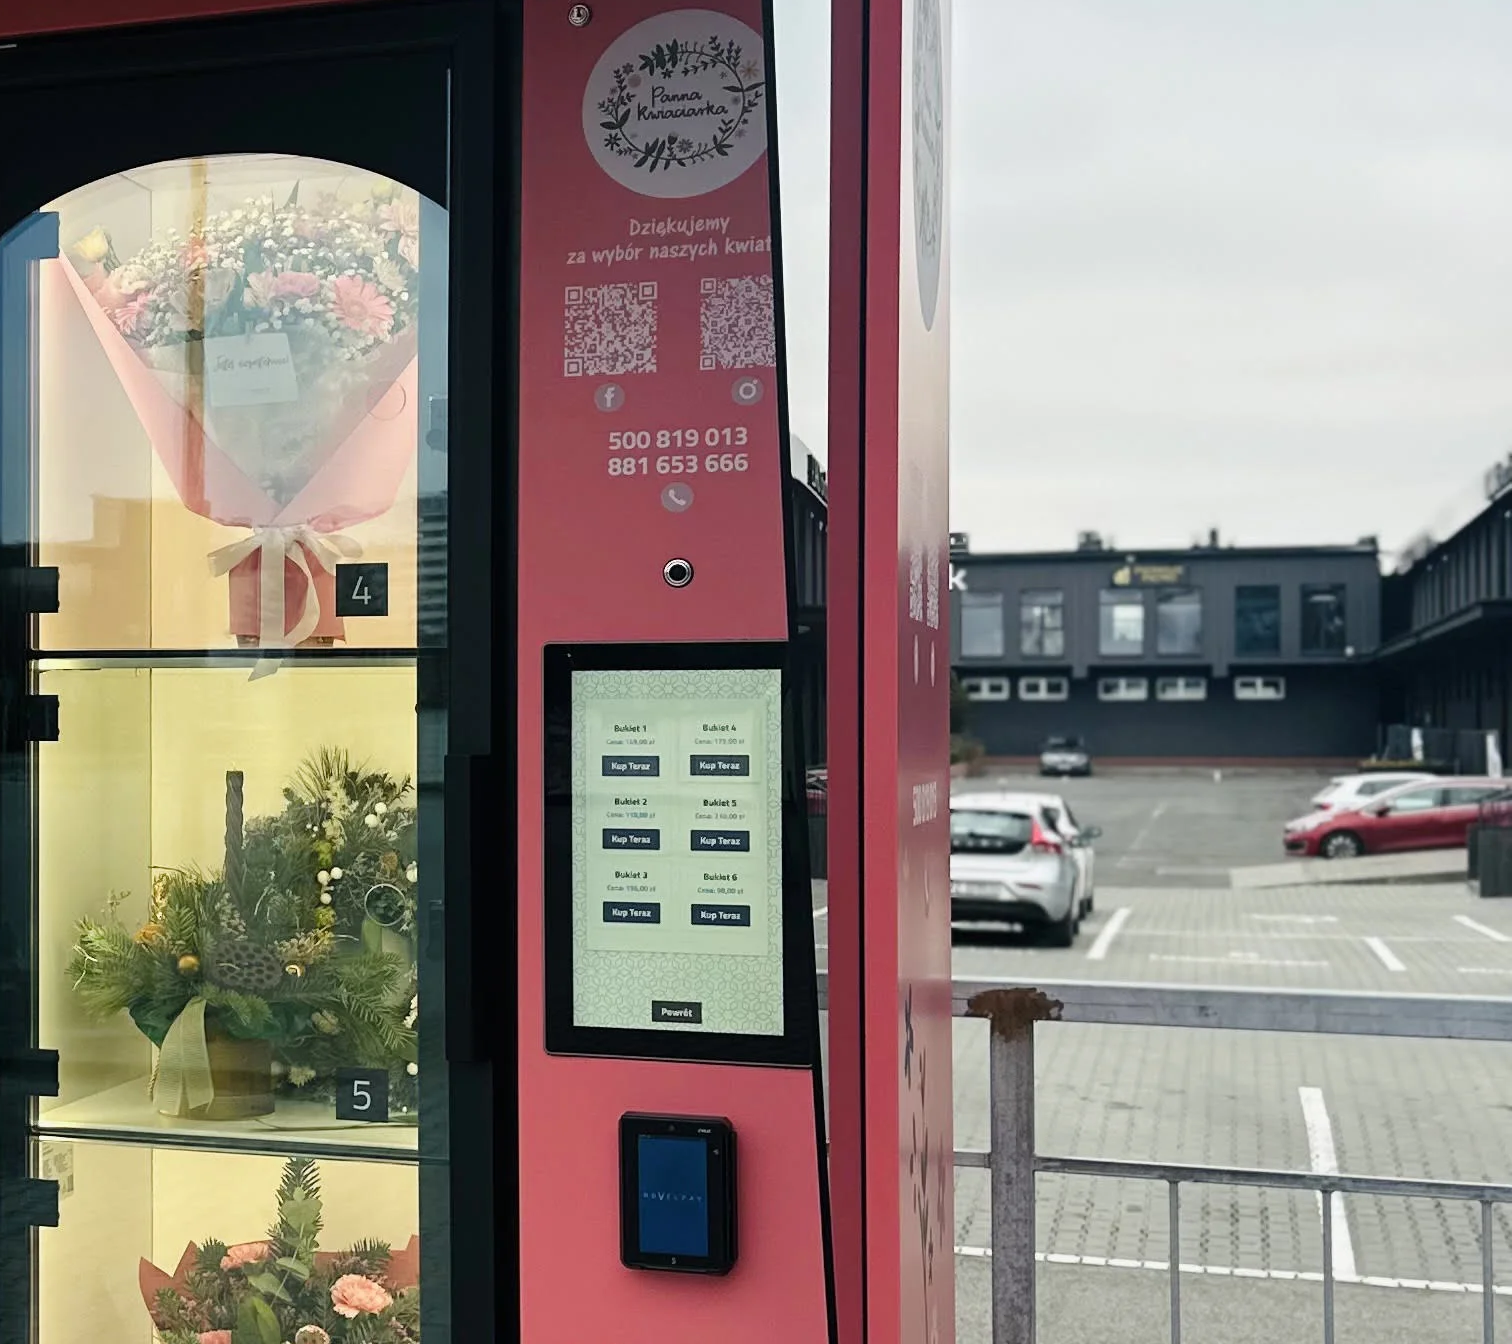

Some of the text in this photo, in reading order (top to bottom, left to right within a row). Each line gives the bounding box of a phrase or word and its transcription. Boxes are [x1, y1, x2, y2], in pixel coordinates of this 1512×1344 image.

[651, 85, 703, 108] Panna
[629, 216, 731, 237] Dziękujemy
[566, 249, 586, 265] za
[592, 242, 643, 266] wybór
[649, 238, 717, 261] naszych
[608, 426, 748, 450] 500 819 013
[608, 453, 749, 476] 881 653 666
[351, 576, 372, 605] 4
[614, 724, 640, 732] Bukiet
[702, 724, 737, 732] Bukiet 4
[611, 762, 651, 772] Kup Teraz
[699, 761, 740, 771] Kup Teraz
[614, 797, 648, 806] Bukiet 2
[703, 799, 737, 807] Bukiet 5
[611, 835, 651, 845] Kup Teraz
[700, 836, 741, 847] Kup Teraz
[614, 870, 648, 879] Bukiet 3
[703, 872, 738, 881] Bukiet 6
[612, 908, 652, 918] Kup Teraz
[700, 911, 741, 921] Kup Teraz
[661, 1007, 693, 1018] Powrót
[352, 1080, 371, 1110] 5
